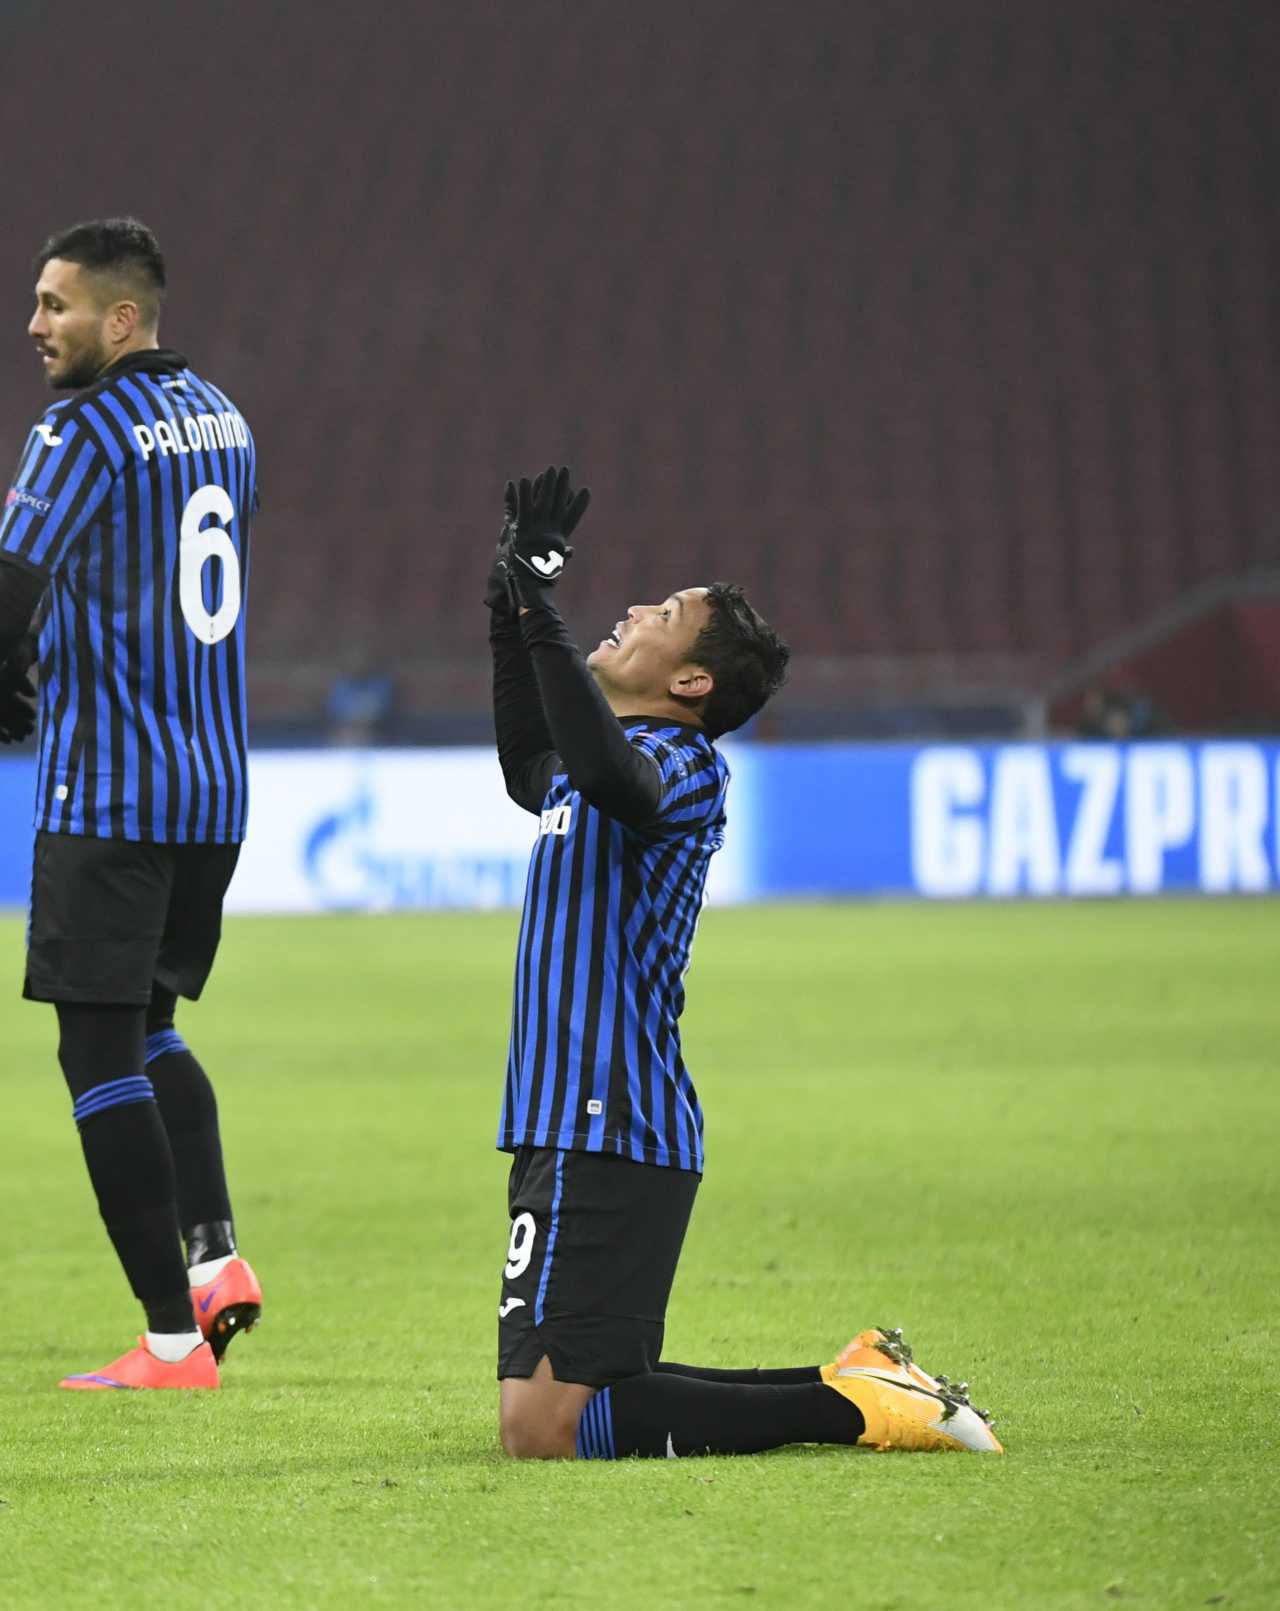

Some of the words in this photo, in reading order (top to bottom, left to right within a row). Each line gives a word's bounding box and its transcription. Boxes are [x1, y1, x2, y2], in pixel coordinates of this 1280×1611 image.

[179, 484, 241, 645] 6
[911, 744, 1280, 896] GAZPR
[505, 1212, 536, 1279] 9
